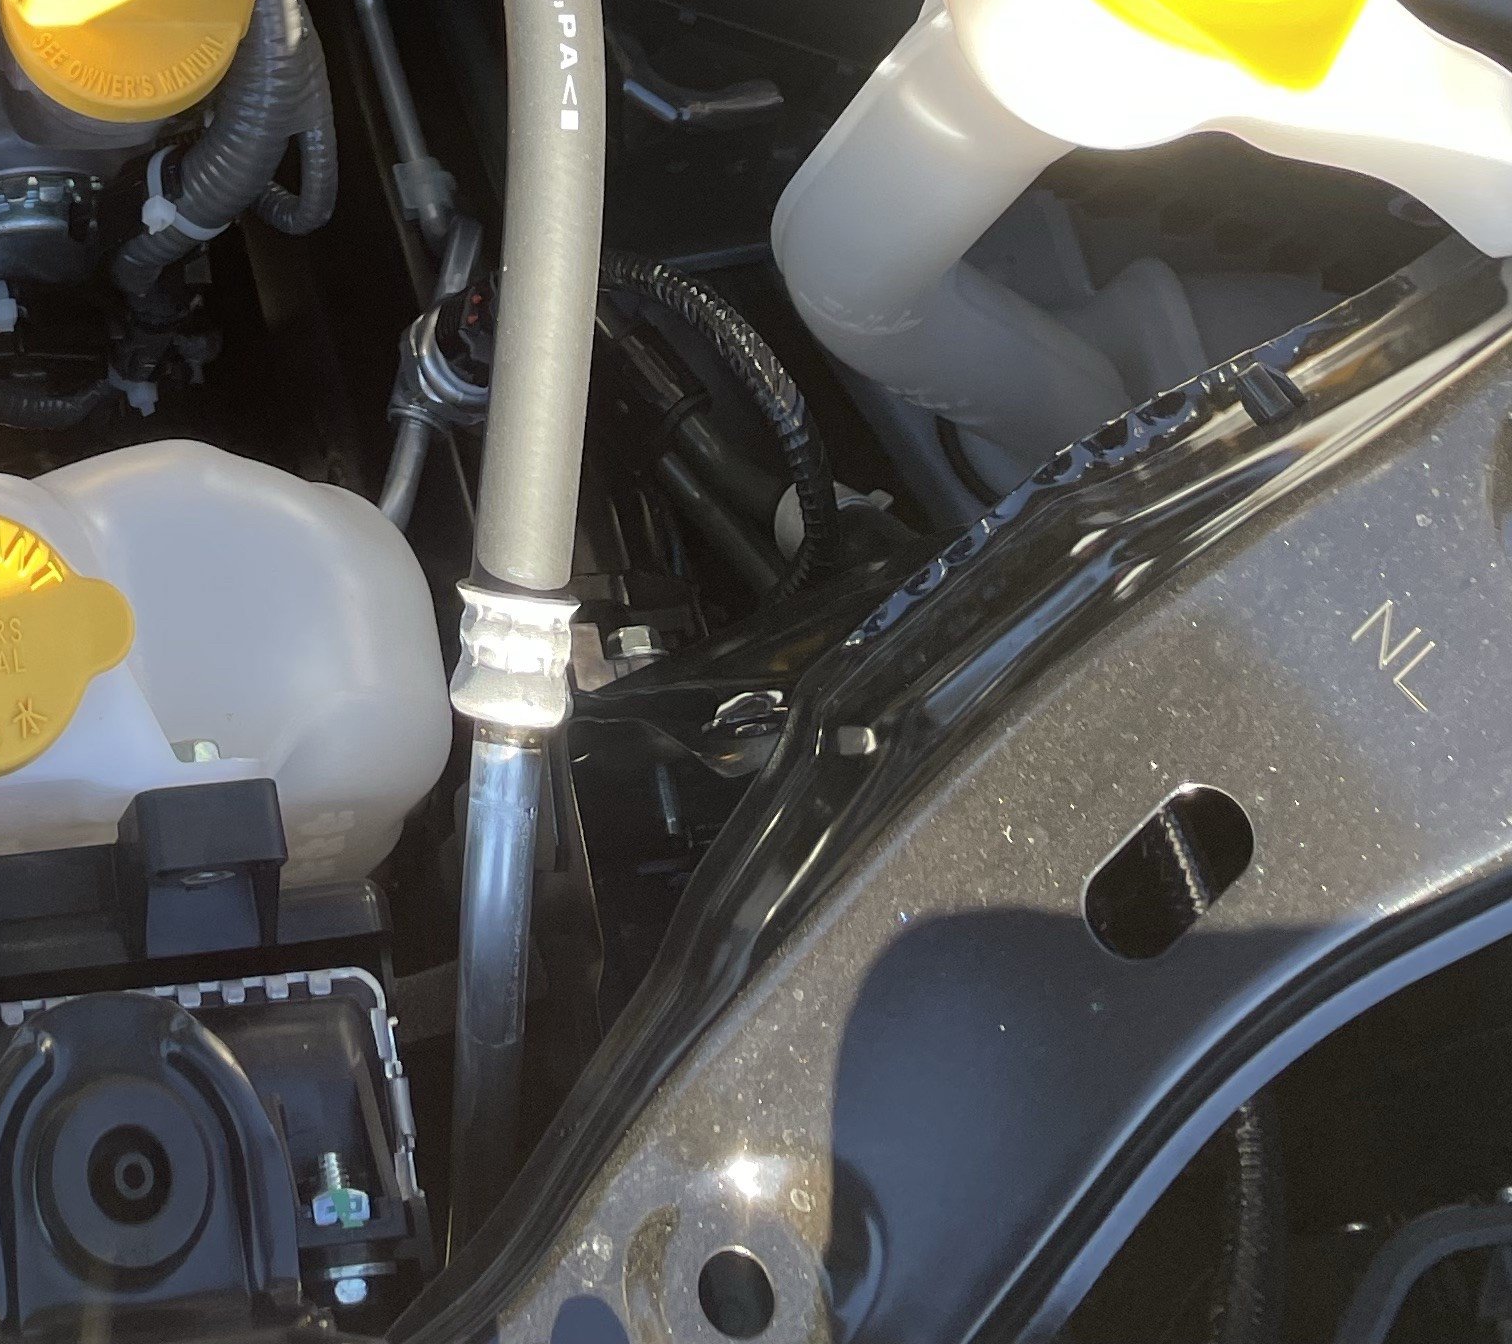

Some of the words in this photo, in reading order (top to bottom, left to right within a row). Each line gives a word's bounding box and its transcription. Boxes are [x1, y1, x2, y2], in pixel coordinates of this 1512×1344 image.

[32, 32, 71, 70] SEE
[69, 63, 155, 98] OWNER'S
[157, 35, 227, 95] MANUAL
